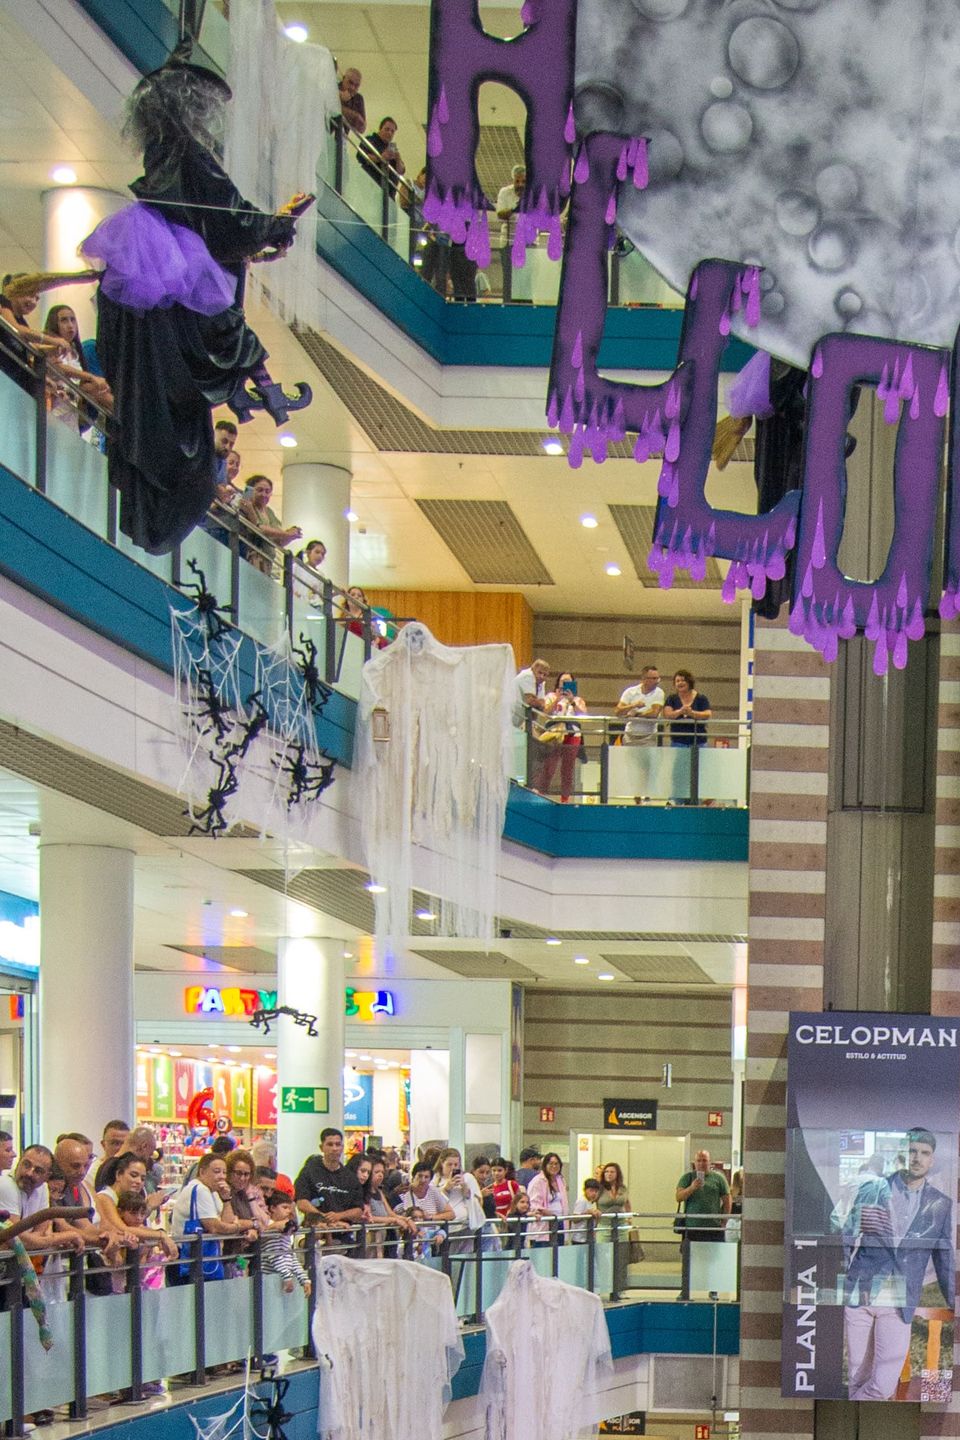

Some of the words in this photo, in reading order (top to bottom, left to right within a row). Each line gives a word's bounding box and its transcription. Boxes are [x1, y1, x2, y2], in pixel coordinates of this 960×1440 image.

[795, 1024, 958, 1047] CELOPMAN
[845, 1052, 869, 1060] ESTILO
[618, 1111, 653, 1120] ASCENSOR
[795, 1264, 817, 1392] PLANTA
